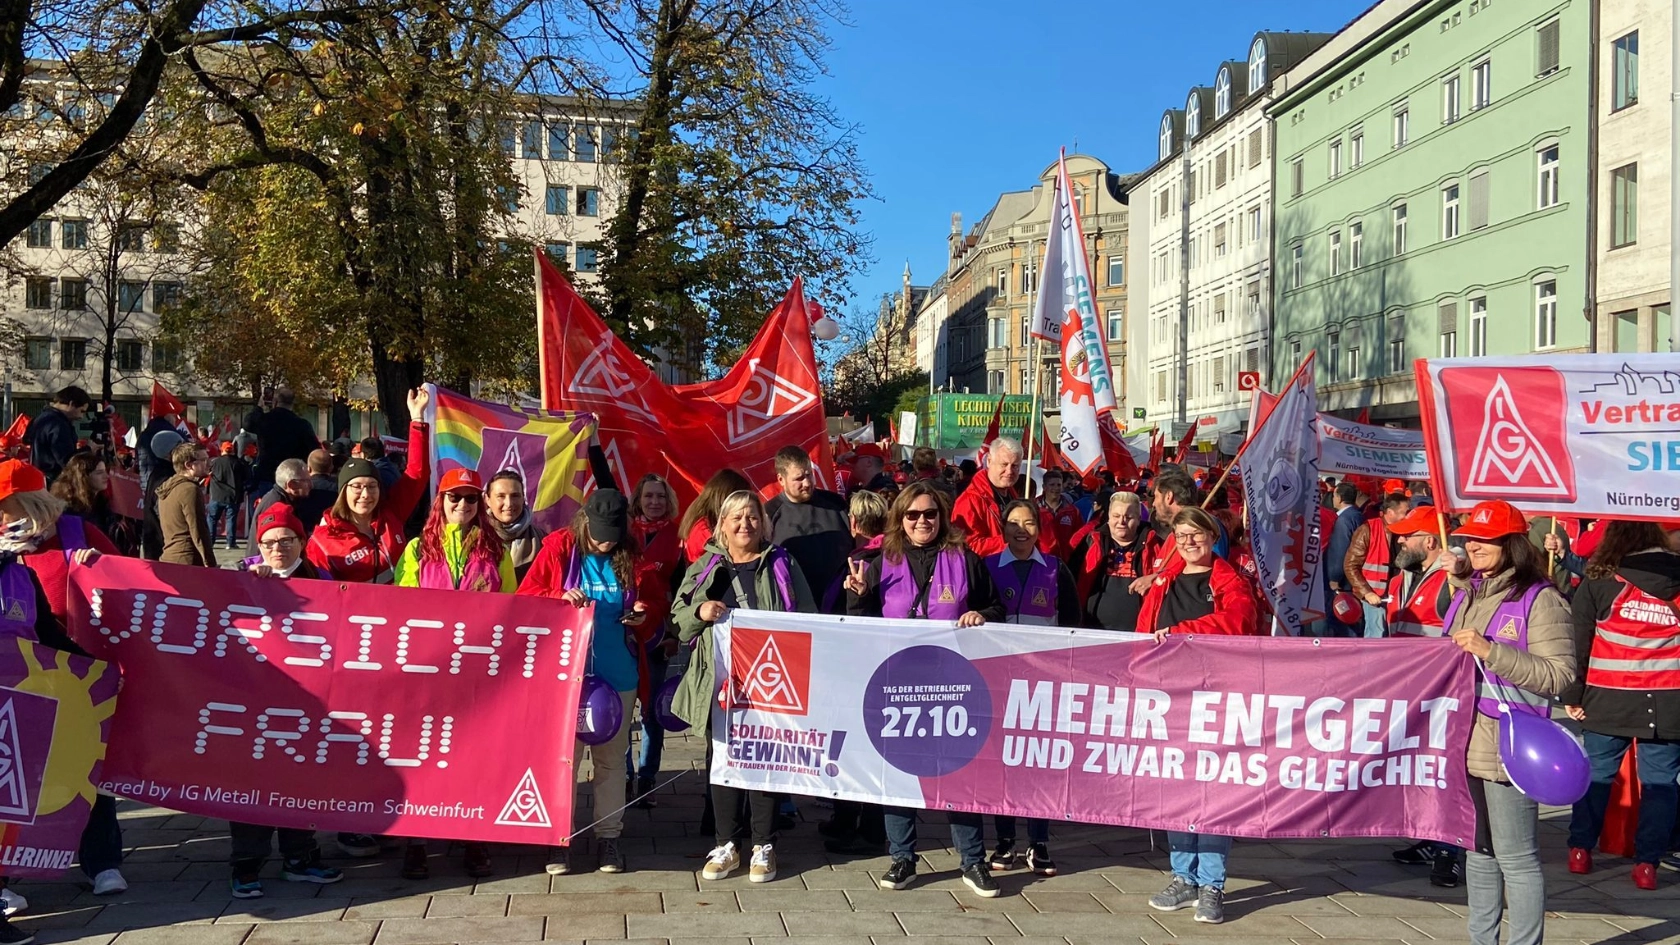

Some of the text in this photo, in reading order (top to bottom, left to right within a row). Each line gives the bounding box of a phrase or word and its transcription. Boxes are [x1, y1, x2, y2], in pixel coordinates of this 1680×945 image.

[1044, 316, 1061, 335] Tra
[1060, 421, 1080, 452] 879
[1335, 461, 1371, 473] Nürnberg
[1345, 445, 1426, 464] SIEMENS
[1606, 492, 1680, 511] Nürnberg
[1244, 464, 1272, 580] Traditionsstandort
[1266, 580, 1287, 604] seit
[1284, 606, 1302, 637] 187
[89, 587, 573, 681] VORSICHT!
[883, 686, 897, 694] TAG
[914, 684, 971, 693] BETRIEBLICHEN
[890, 693, 964, 702] ENTGELTGLEICHHEIT
[880, 705, 977, 738] 27.10.
[1002, 679, 1460, 755] MEHR ENTGELT
[194, 702, 454, 769] FRAU!
[729, 723, 828, 747] SOLIDARITÄT
[740, 761, 765, 770] FRAUEN
[775, 764, 788, 772] DER
[789, 765, 796, 773] IG
[797, 766, 821, 776] METALL
[1002, 735, 1448, 792] UND ZWAR DAS GLEICHE!
[149, 780, 171, 801] by
[179, 784, 199, 800] IG
[204, 787, 260, 806] Metall
[268, 792, 375, 813] Frauenteam
[383, 798, 485, 820] Schweinfurt
[0, 845, 74, 870] LERINNE
